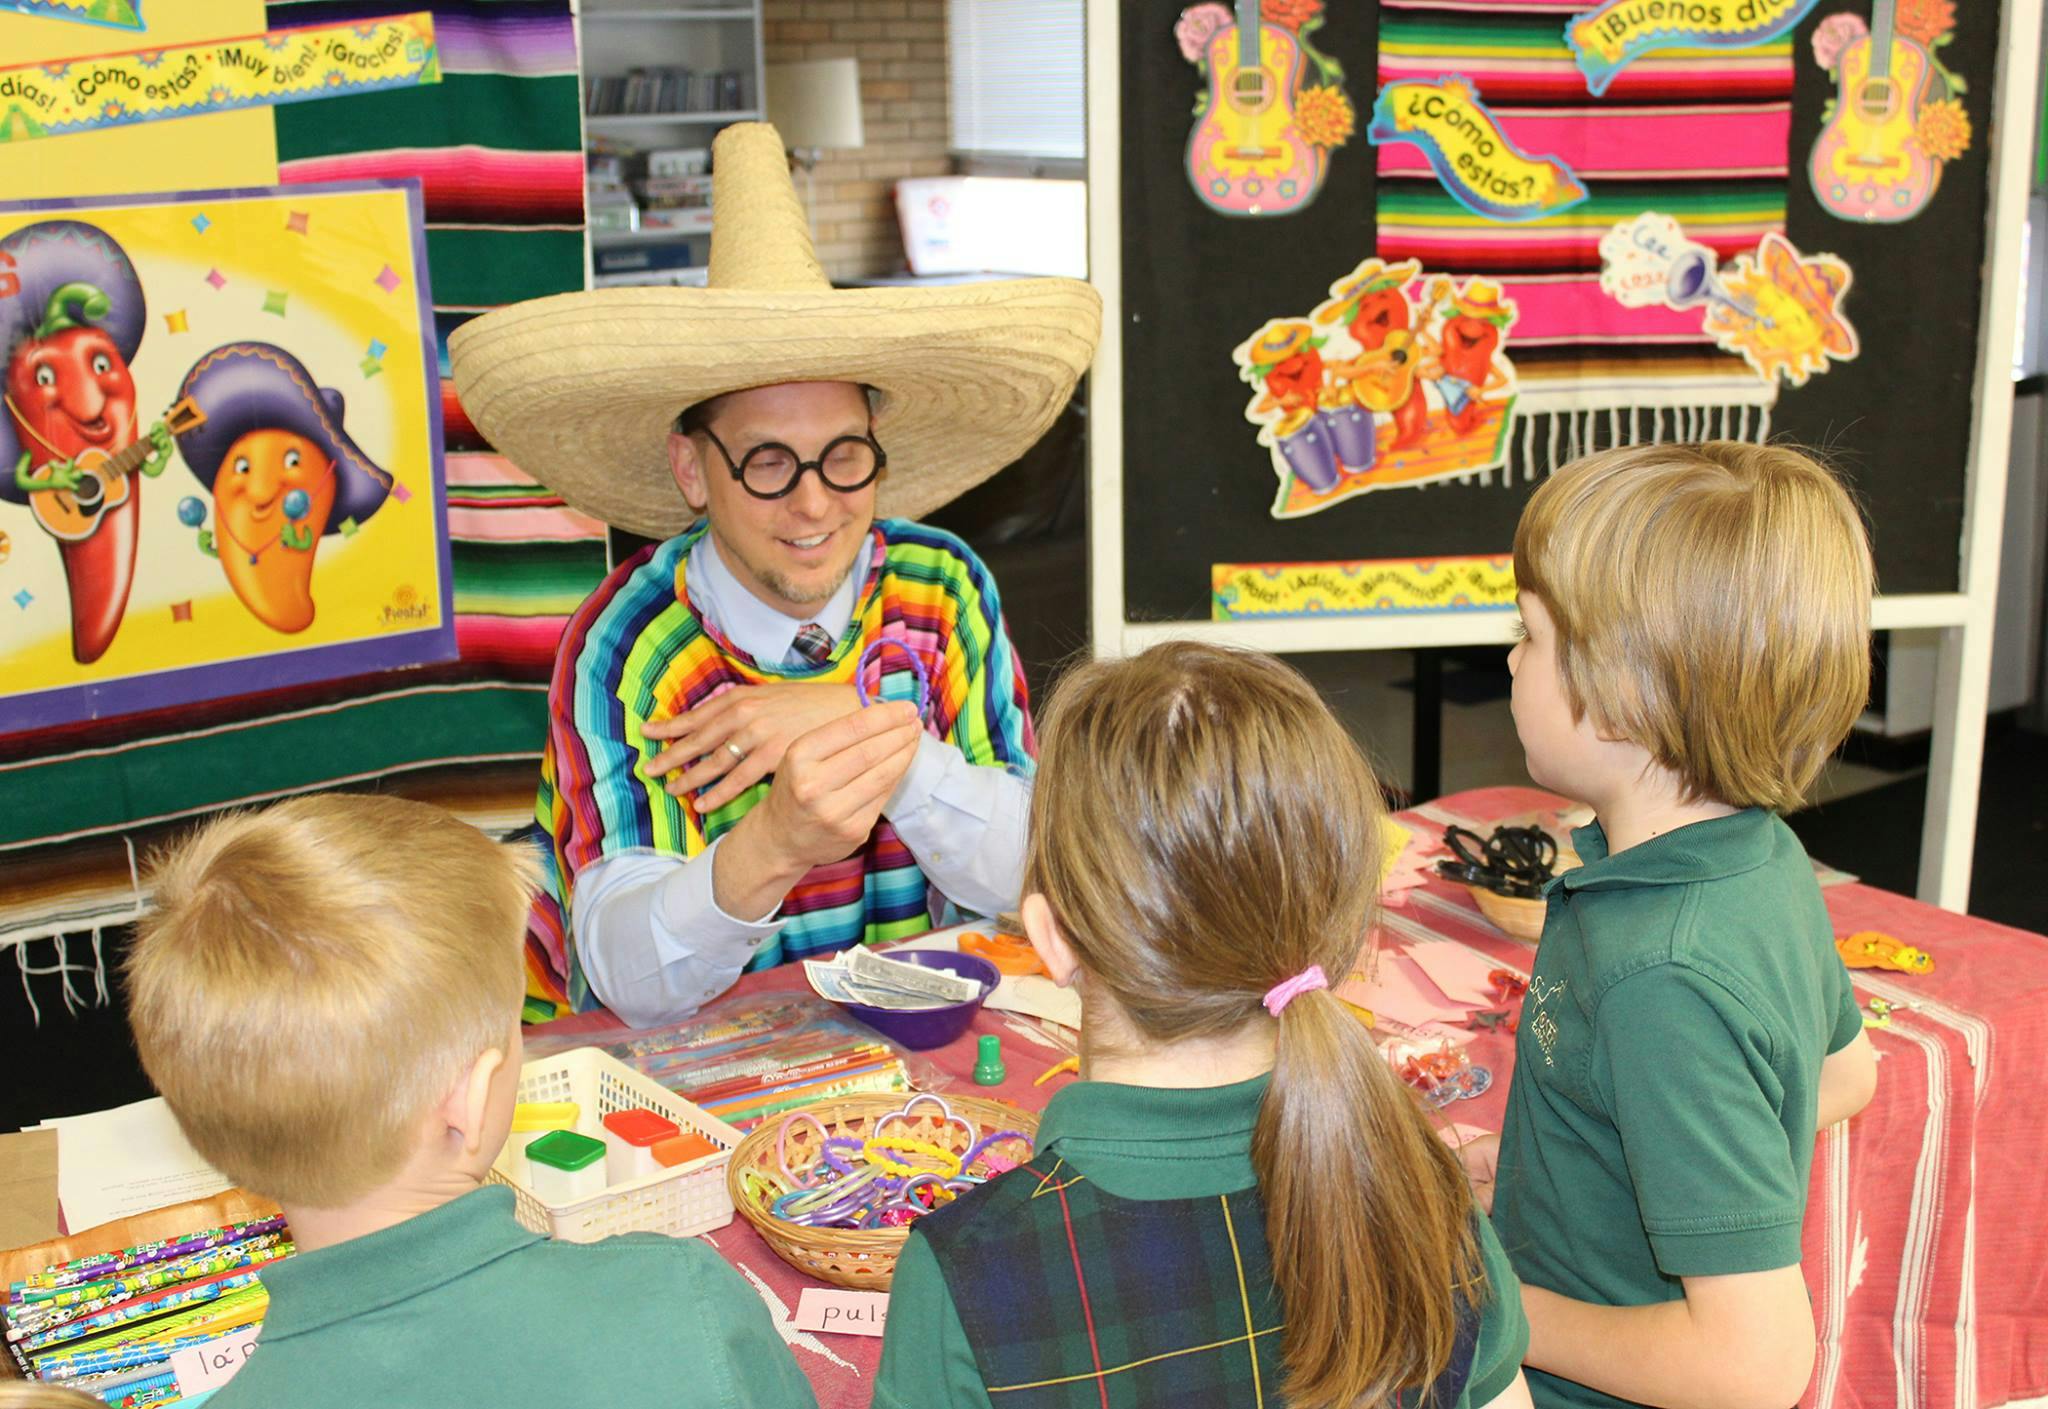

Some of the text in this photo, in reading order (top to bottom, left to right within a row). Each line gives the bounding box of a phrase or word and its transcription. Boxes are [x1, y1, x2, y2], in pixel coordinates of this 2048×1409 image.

[217, 48, 269, 78] ¡Muy
[273, 44, 318, 84] bien!
[325, 26, 404, 69] ¡Gracias!
